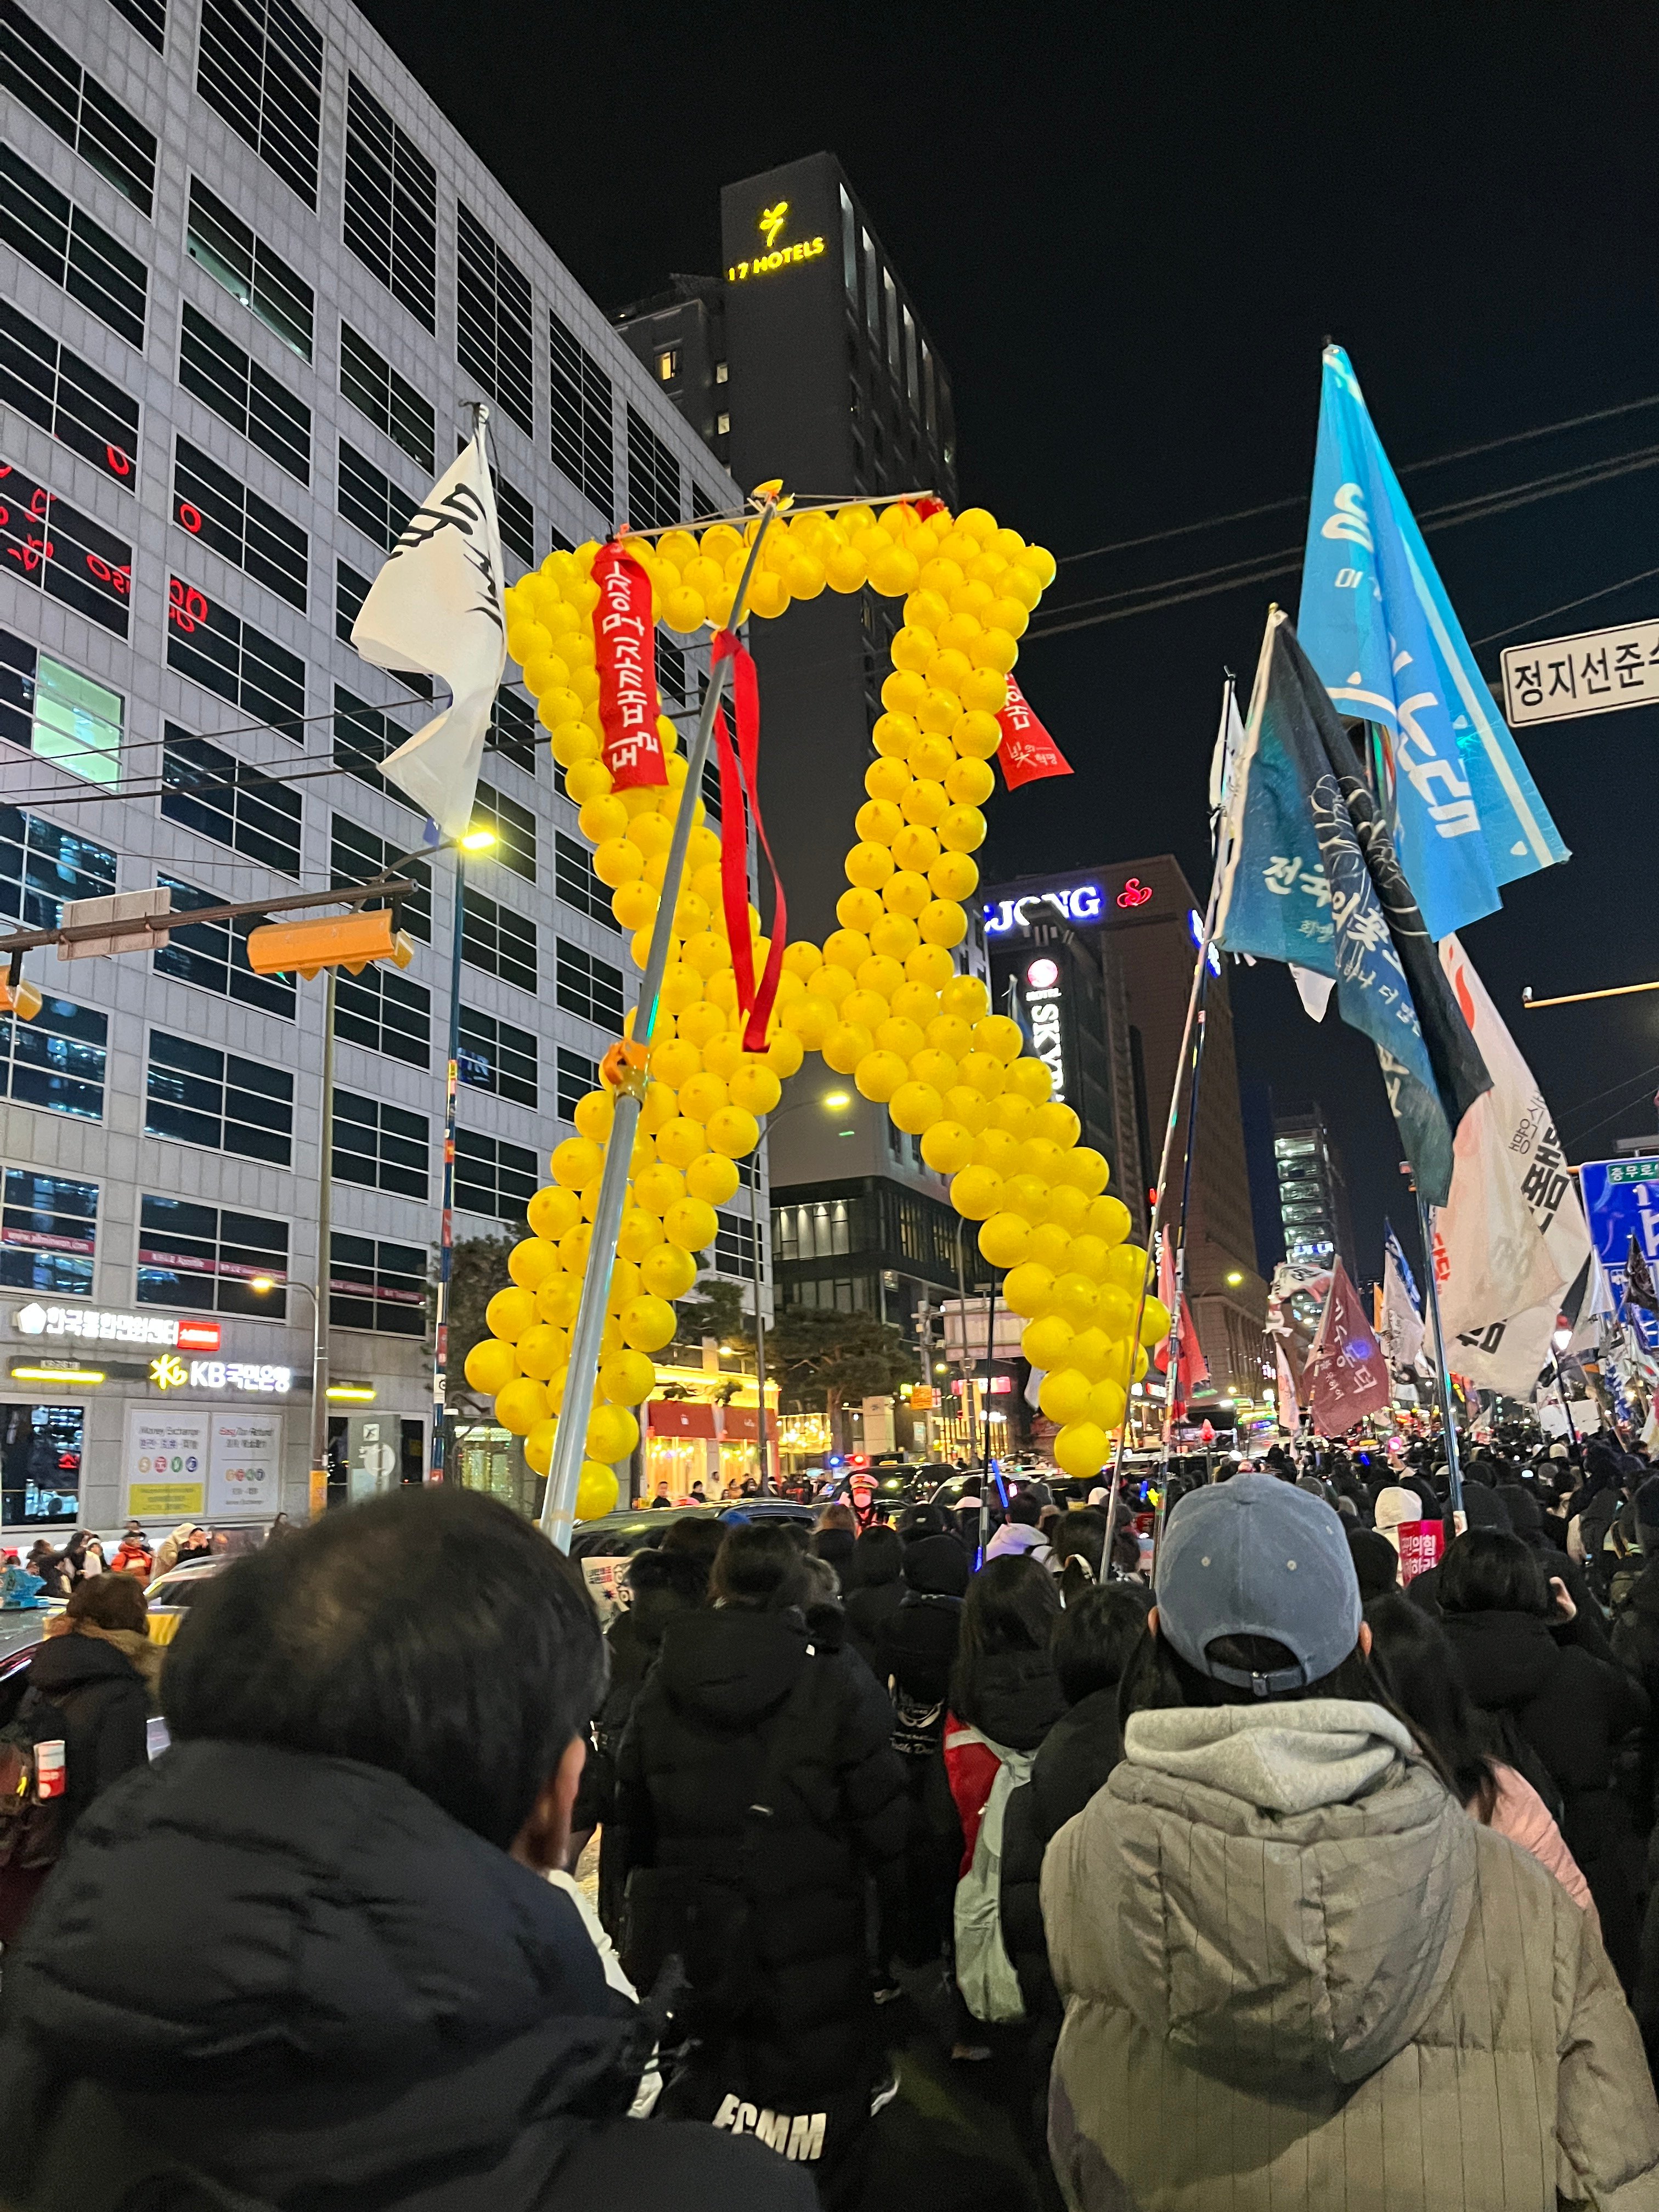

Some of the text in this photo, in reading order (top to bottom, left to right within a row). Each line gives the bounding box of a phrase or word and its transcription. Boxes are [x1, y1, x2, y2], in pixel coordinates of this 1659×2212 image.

[728, 236, 825, 280] 17 HOTELS
[602, 561, 658, 771] 될 때까지 모이자
[190, 1361, 290, 1393] KB국민은행
